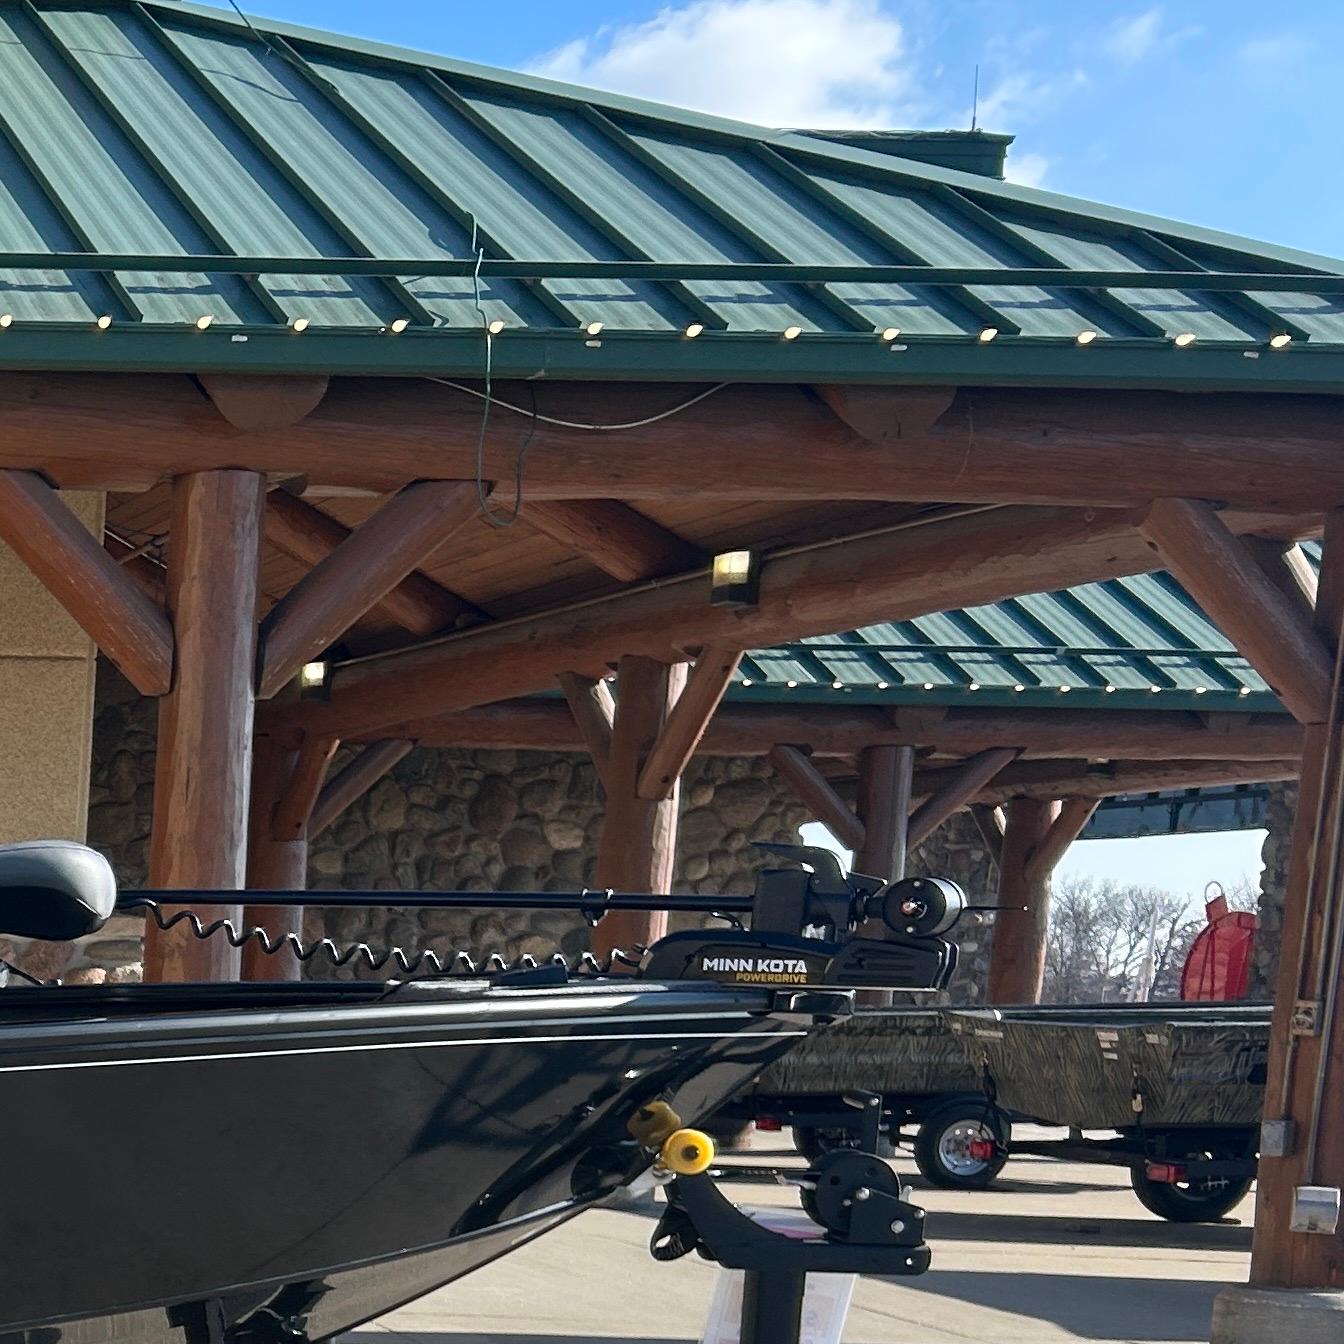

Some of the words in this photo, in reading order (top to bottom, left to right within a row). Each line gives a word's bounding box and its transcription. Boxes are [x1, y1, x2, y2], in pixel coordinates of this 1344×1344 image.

[702, 957, 753, 972] MINN
[757, 959, 808, 974] KOTA
[735, 972, 808, 984] POWERDRIVE
